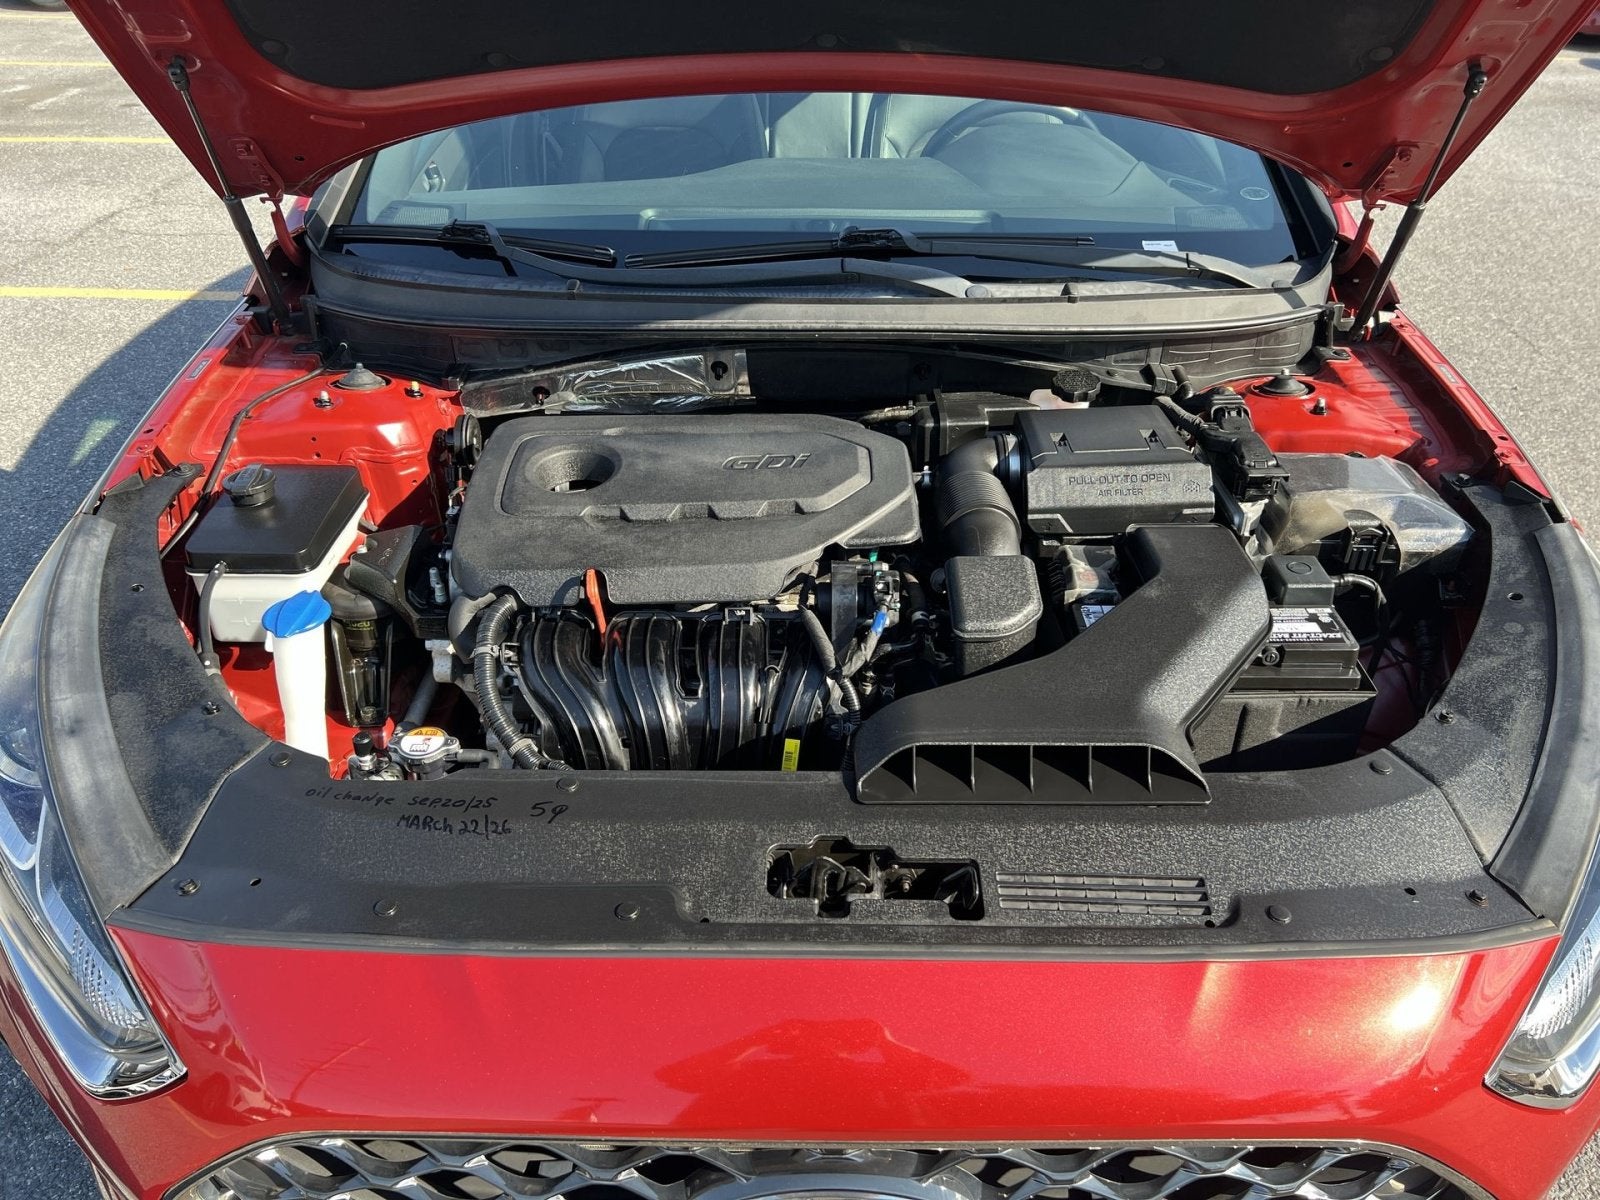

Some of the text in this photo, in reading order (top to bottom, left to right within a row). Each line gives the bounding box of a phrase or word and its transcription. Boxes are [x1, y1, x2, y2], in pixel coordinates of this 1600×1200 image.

[1123, 474, 1138, 483] TO
[1140, 473, 1171, 483] OPEN
[1098, 488, 1144, 497] AIR FILTER
